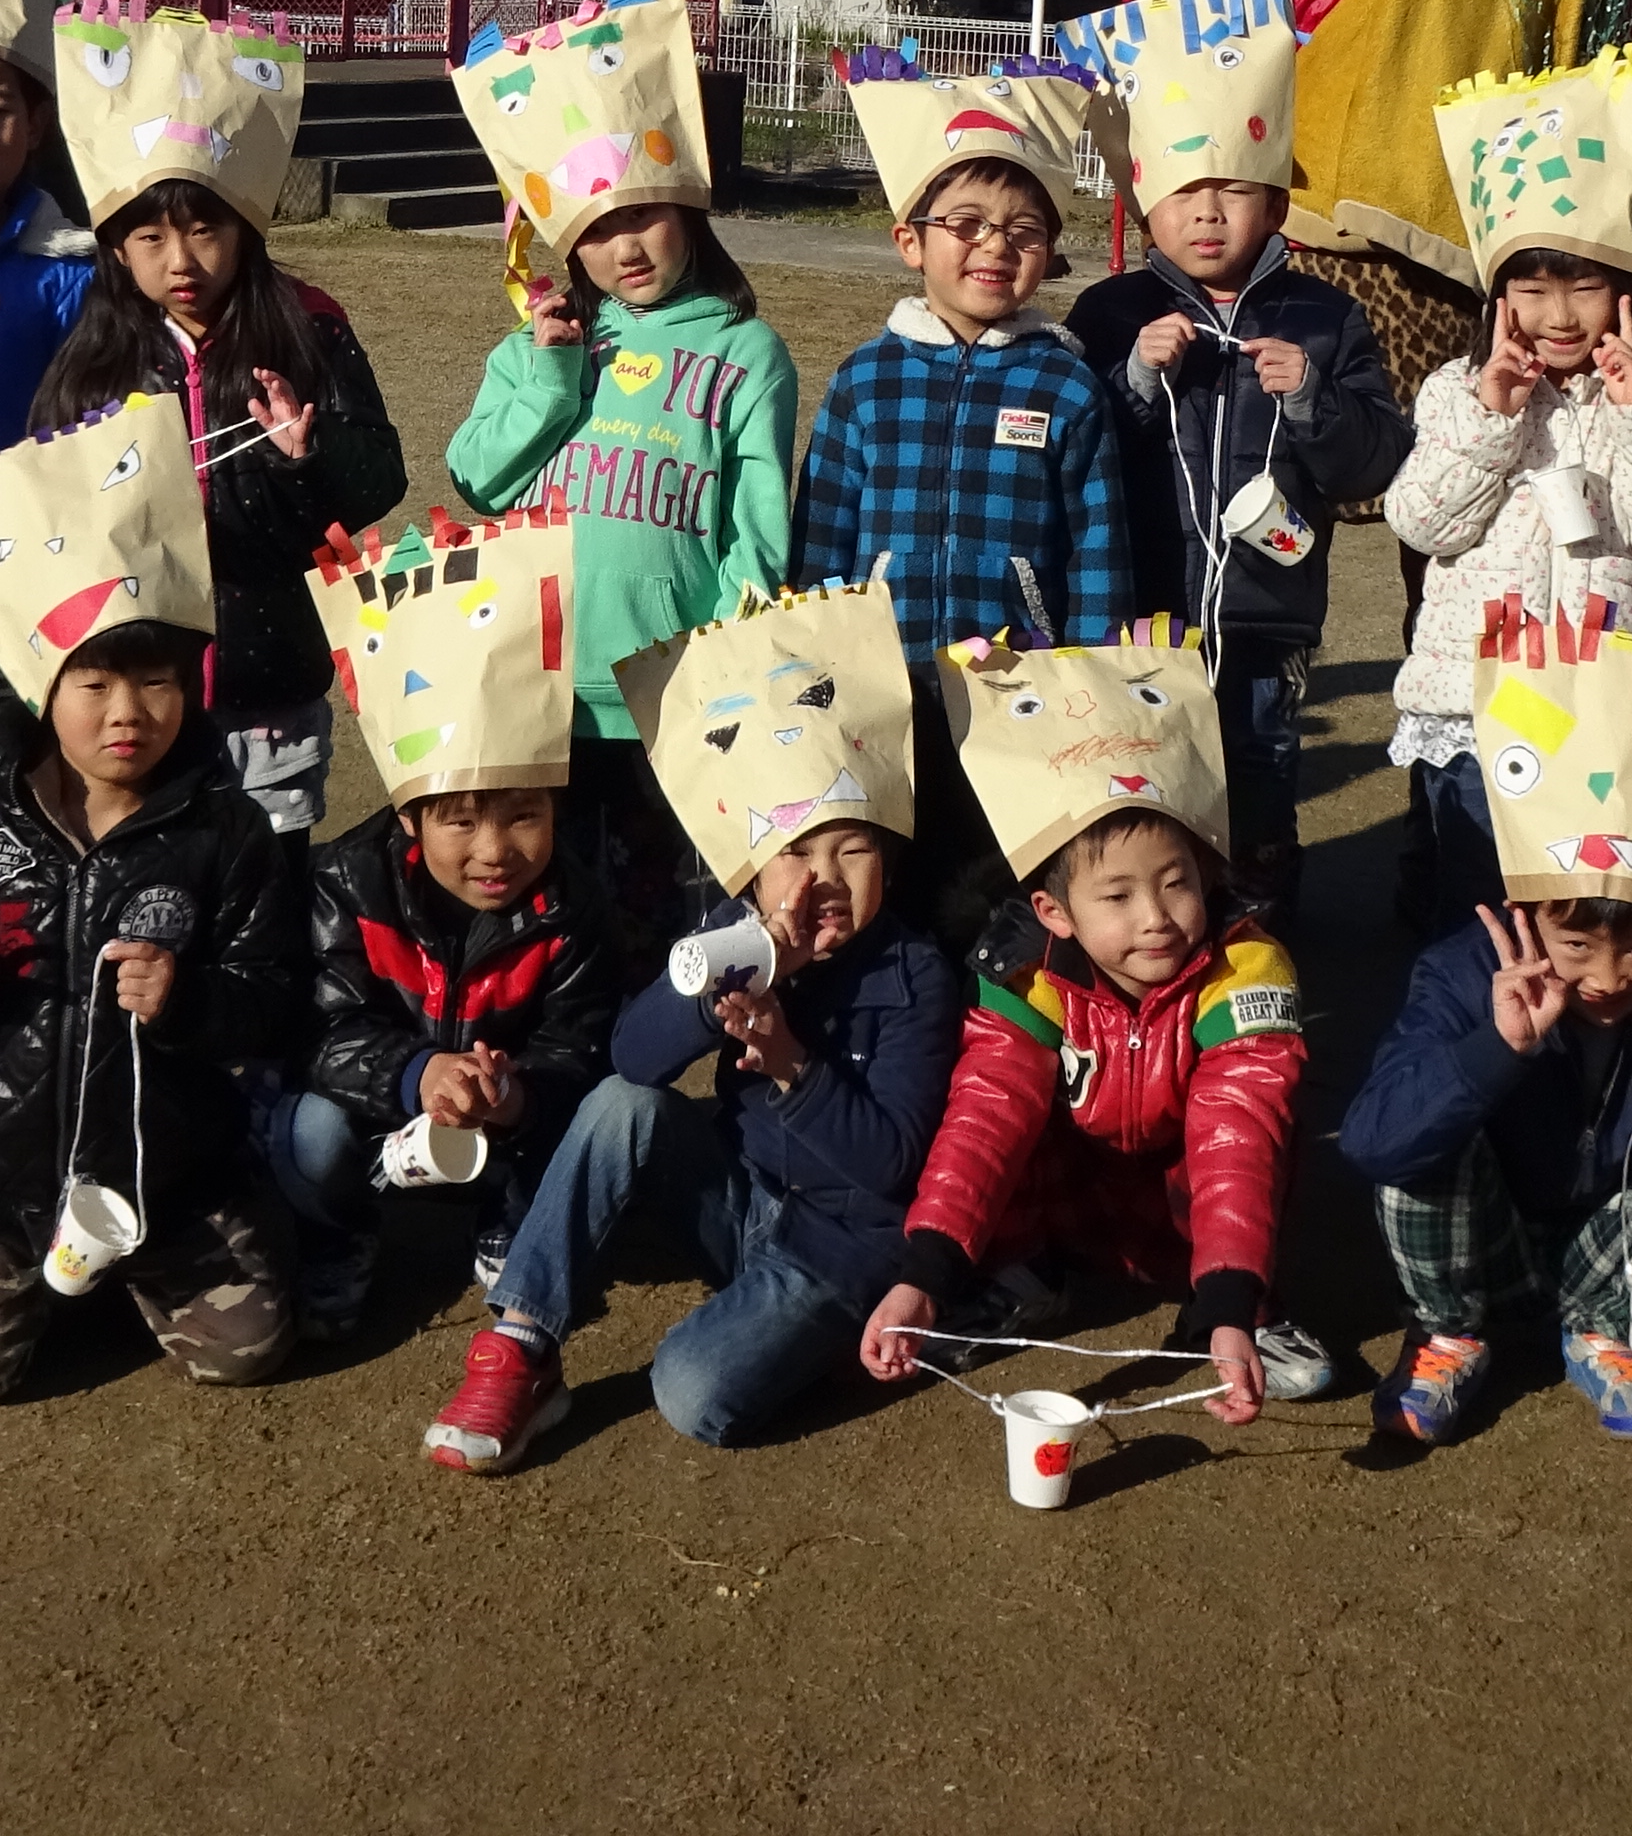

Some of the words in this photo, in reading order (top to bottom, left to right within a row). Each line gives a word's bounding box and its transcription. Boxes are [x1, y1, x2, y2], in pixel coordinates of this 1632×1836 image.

[615, 362, 653, 380] and
[663, 347, 748, 429] YOU
[1001, 413, 1030, 424] Field
[592, 417, 642, 443] every
[647, 422, 682, 454] day
[1006, 429, 1043, 442] Sports
[1239, 1004, 1272, 1023] GREAT
